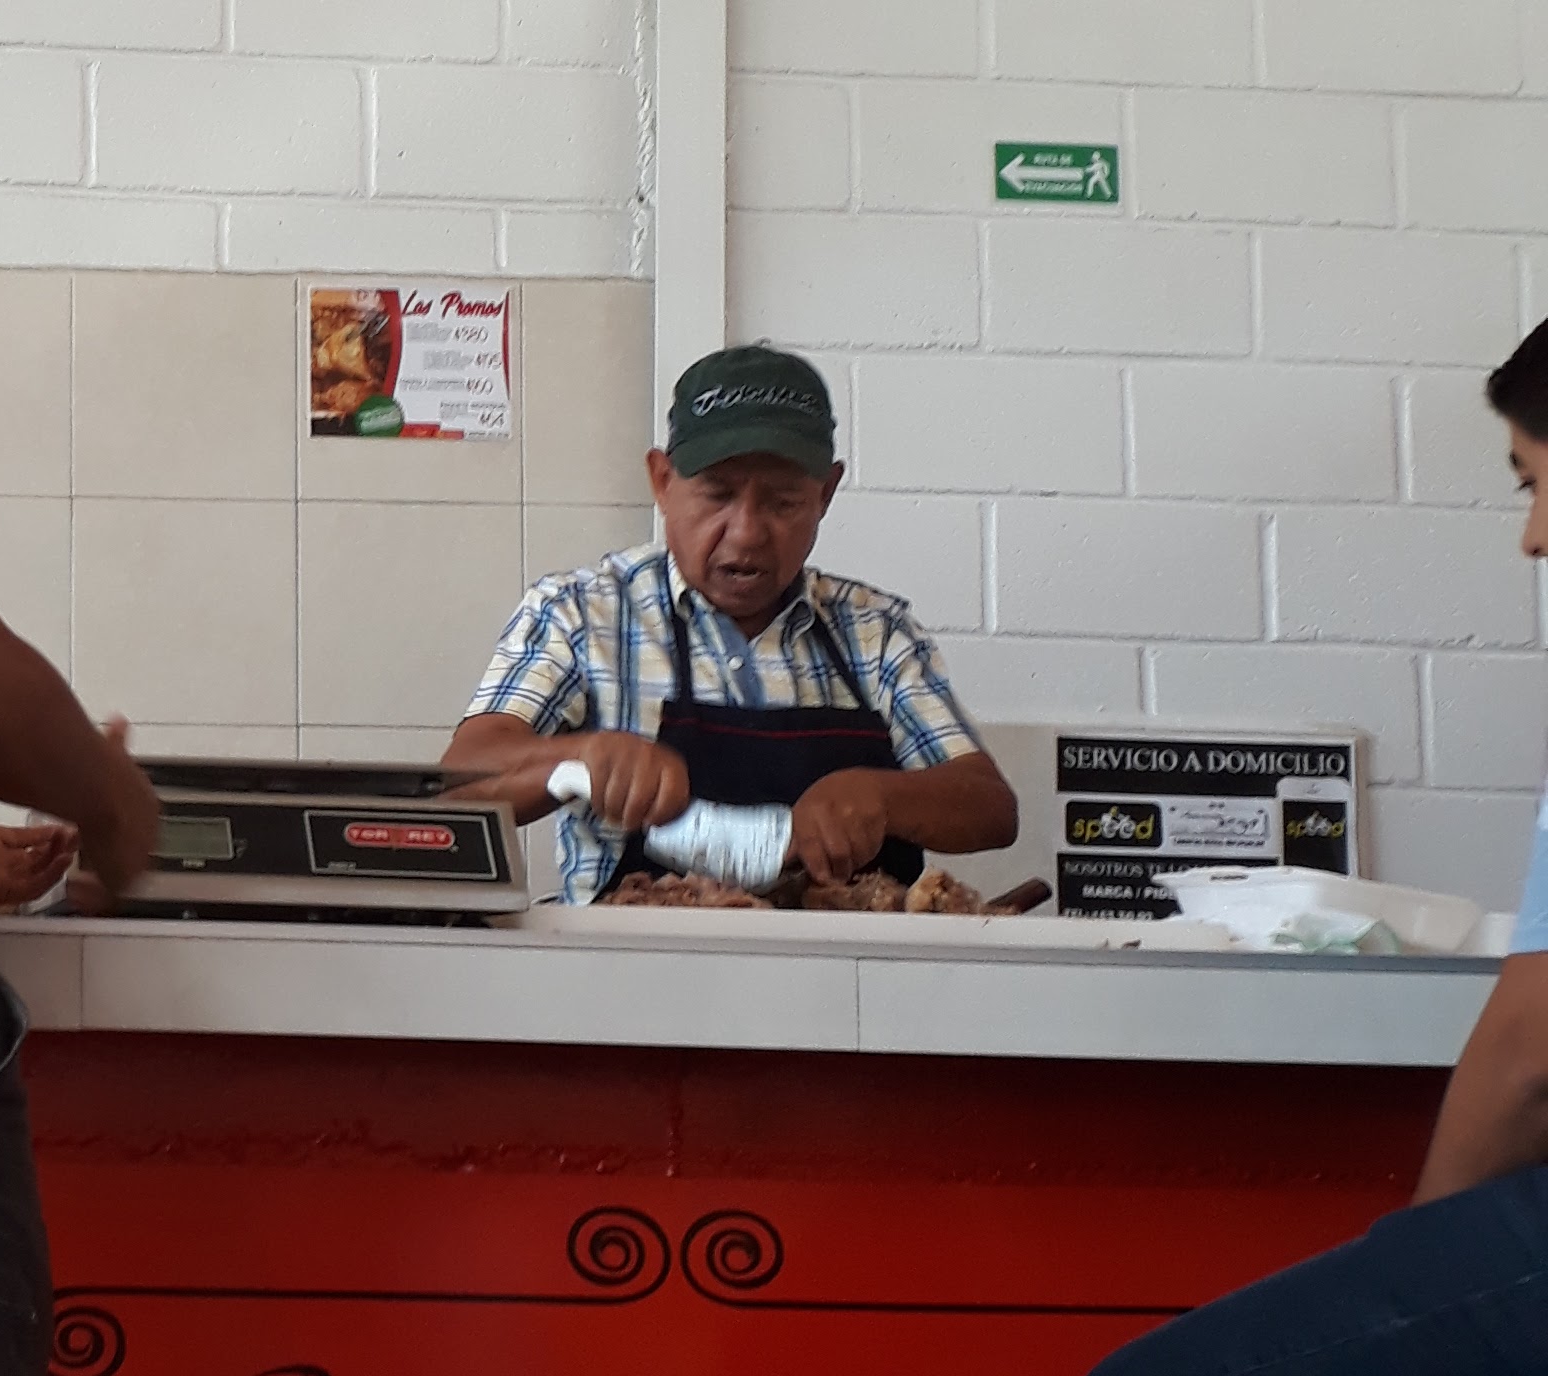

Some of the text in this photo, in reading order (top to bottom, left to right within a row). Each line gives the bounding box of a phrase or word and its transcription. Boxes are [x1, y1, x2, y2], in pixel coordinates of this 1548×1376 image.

[441, 290, 502, 321] Promos
[1063, 746, 1345, 776] SERVICIO A DOMICILIO
